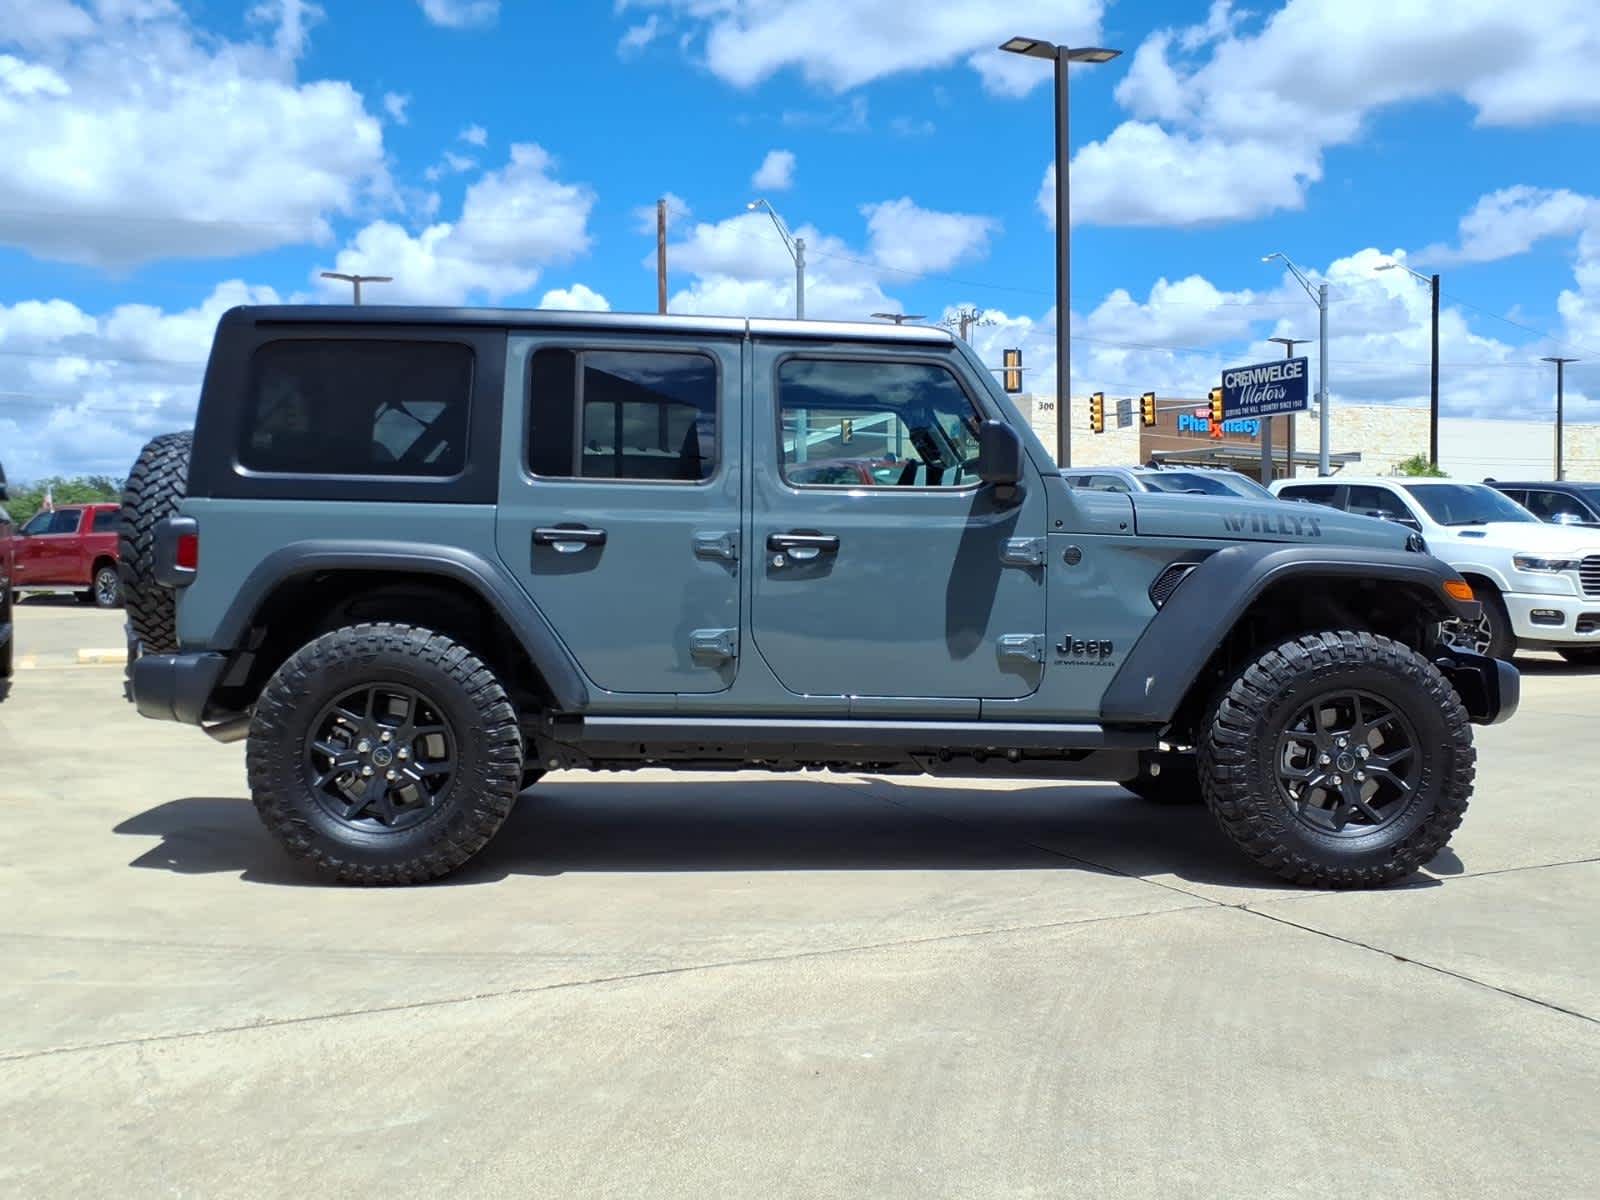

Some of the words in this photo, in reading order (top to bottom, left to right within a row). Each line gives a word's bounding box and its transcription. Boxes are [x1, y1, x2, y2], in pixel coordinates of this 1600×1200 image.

[1225, 361, 1303, 389] CRENWELGE
[1240, 380, 1287, 405] Motors
[1039, 401, 1055, 410] 300
[1223, 511, 1321, 536] WILLYS
[1055, 634, 1113, 659] Jeep
